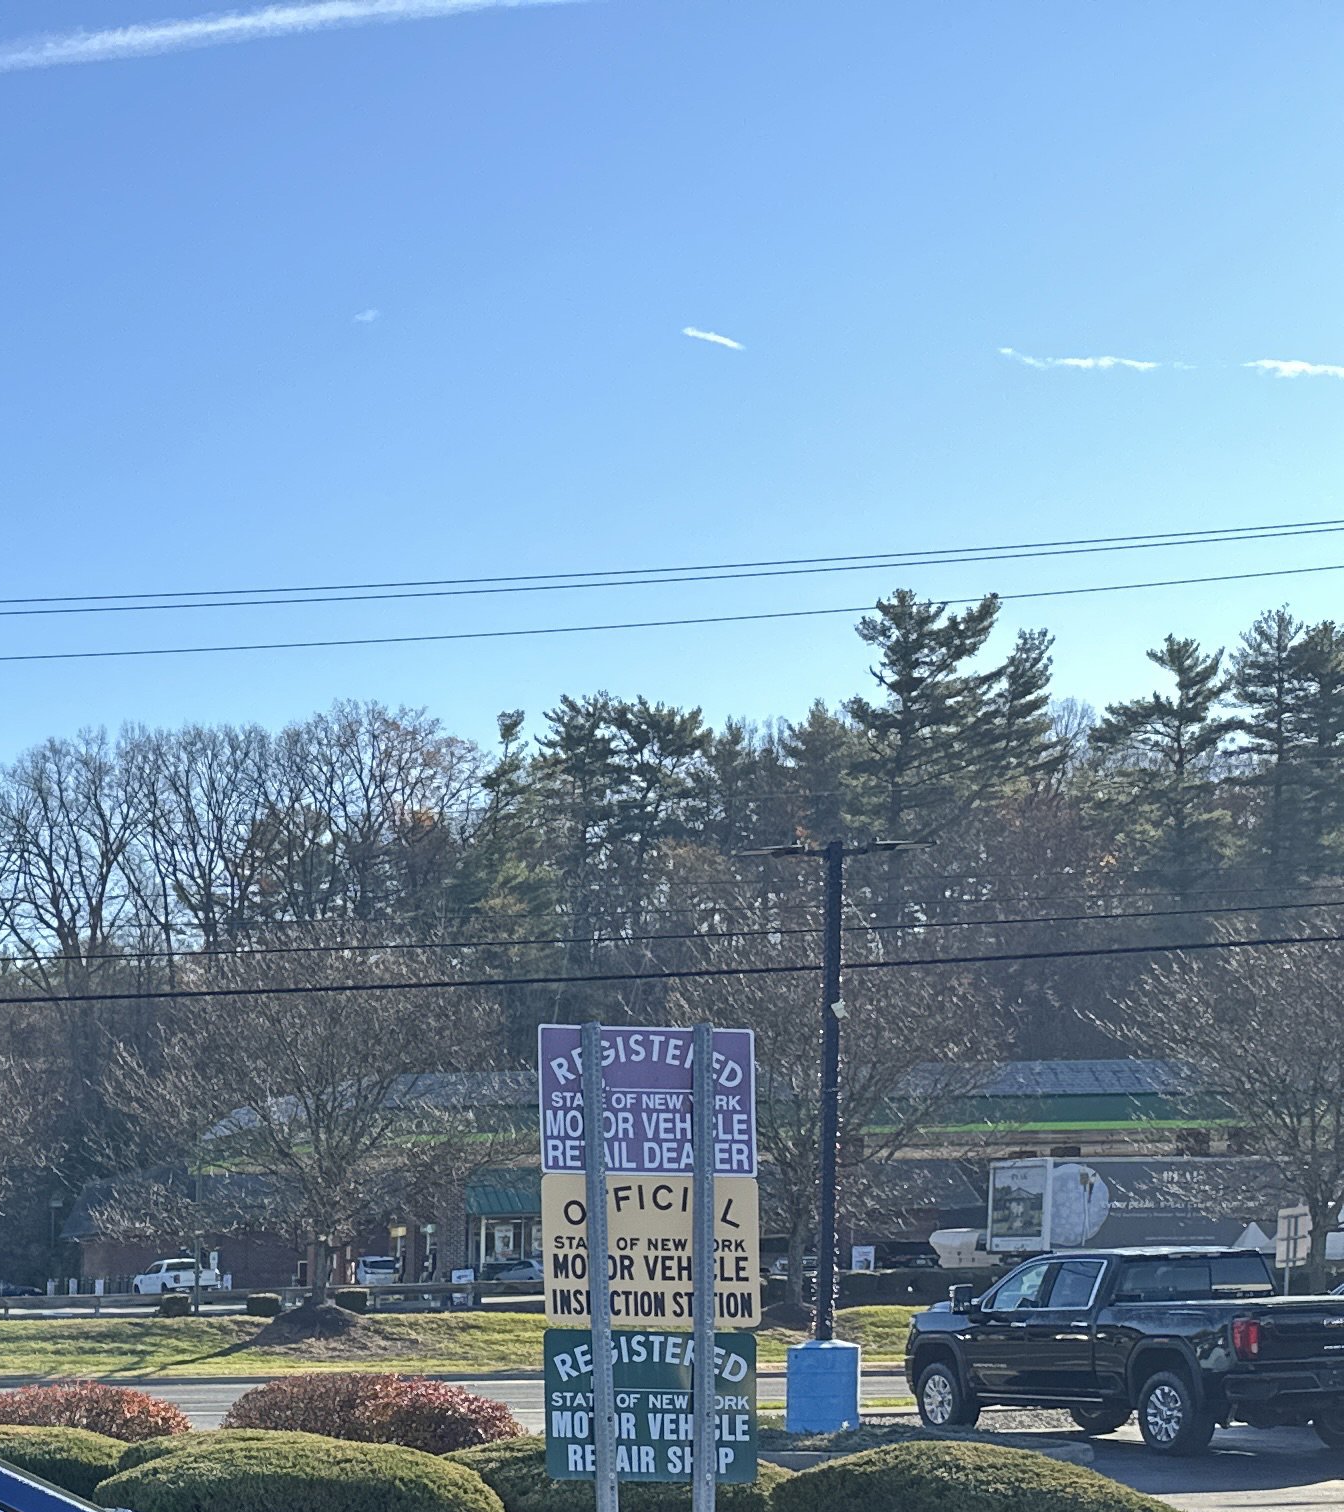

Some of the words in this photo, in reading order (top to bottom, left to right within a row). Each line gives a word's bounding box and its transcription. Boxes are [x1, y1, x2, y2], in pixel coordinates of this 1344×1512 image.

[551, 1092, 606, 1108] STA
[612, 1093, 637, 1109] OF
[642, 1094, 683, 1110] NEW
[688, 1094, 741, 1111] RK
[546, 1110, 634, 1139] MOOR
[641, 1113, 748, 1140] VEHLE
[547, 1140, 636, 1168] REAIL
[643, 1142, 749, 1170] DEAER
[564, 1184, 740, 1228] OFICIL
[554, 1236, 589, 1249] STA
[616, 1237, 640, 1251] OF
[647, 1238, 688, 1252] NEW
[553, 1254, 634, 1280] MOOR
[643, 1255, 749, 1282] VEHLE
[552, 1288, 666, 1317] INSCTION
[672, 1291, 753, 1318] STION
[551, 1392, 594, 1407] STAT
[616, 1393, 641, 1408] OF
[648, 1394, 688, 1409] NEW
[714, 1396, 749, 1410] ORK
[647, 1412, 750, 1442] VEHLE
[568, 1444, 655, 1473] REAIR
[667, 1446, 735, 1474] SHP
